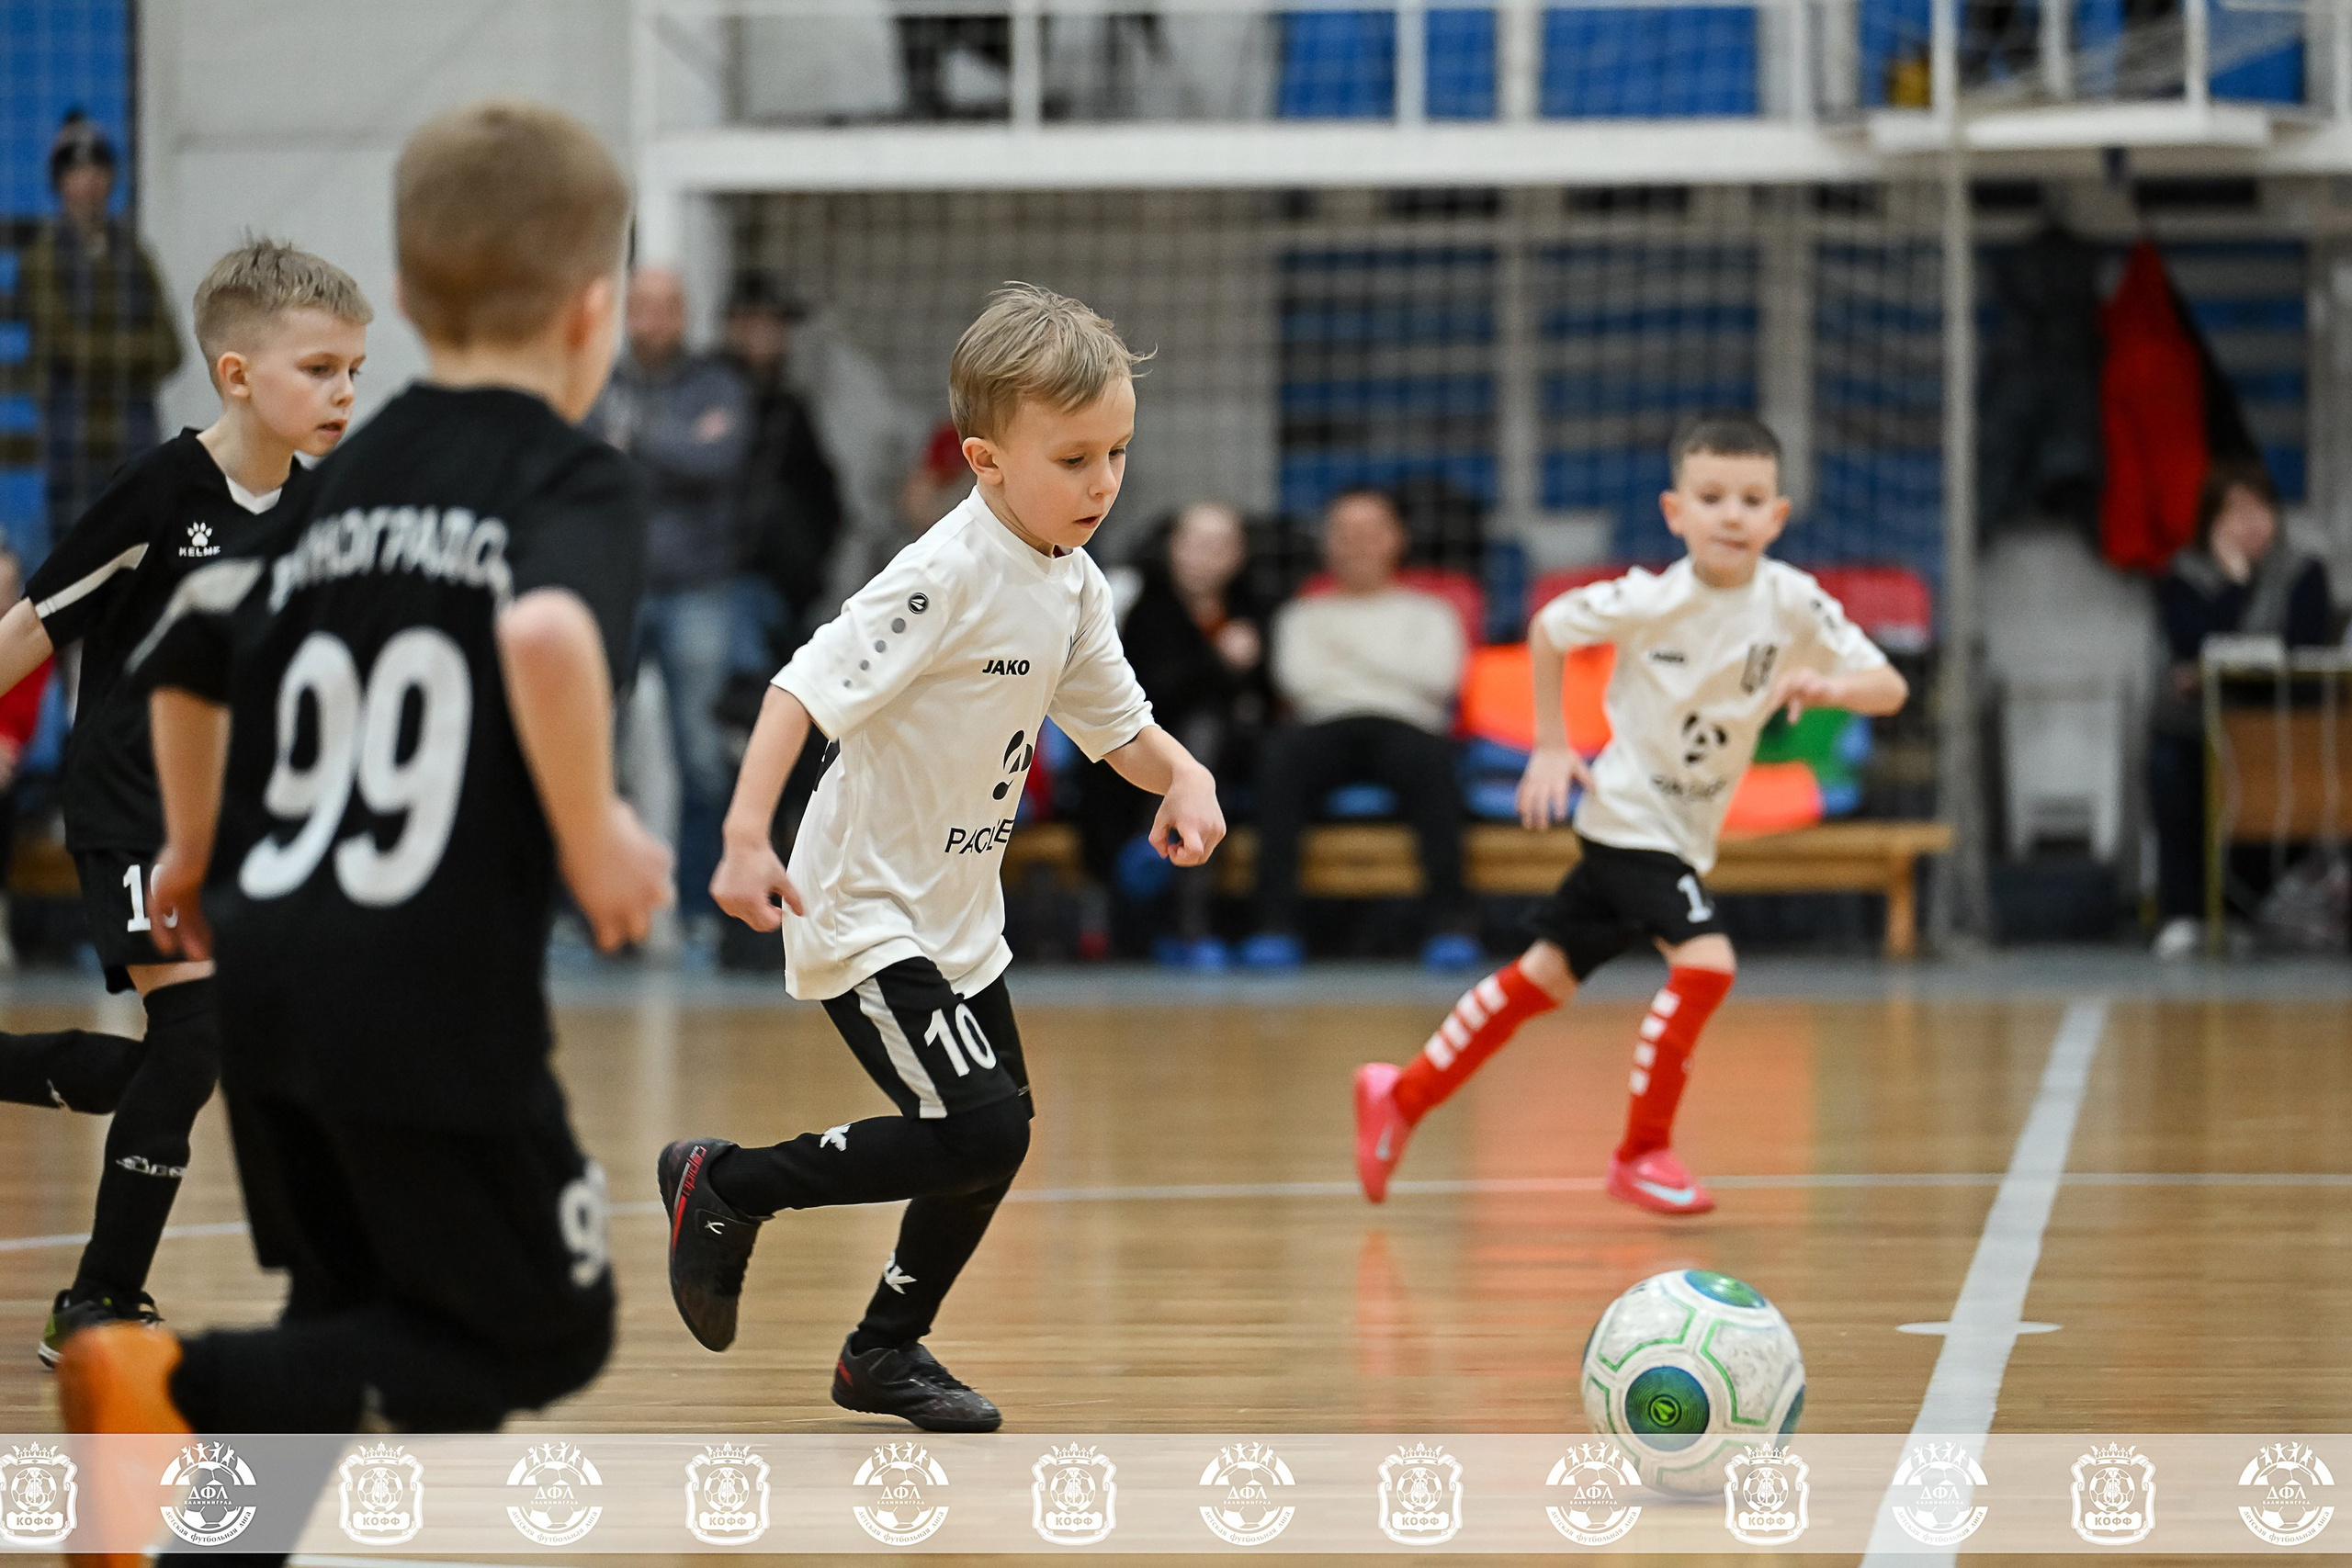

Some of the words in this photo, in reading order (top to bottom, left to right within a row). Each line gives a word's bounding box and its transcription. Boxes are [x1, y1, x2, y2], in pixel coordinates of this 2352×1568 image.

[982, 660, 1031, 675] JAKO
[238, 626, 473, 908] 99
[923, 1002, 997, 1077] 10
